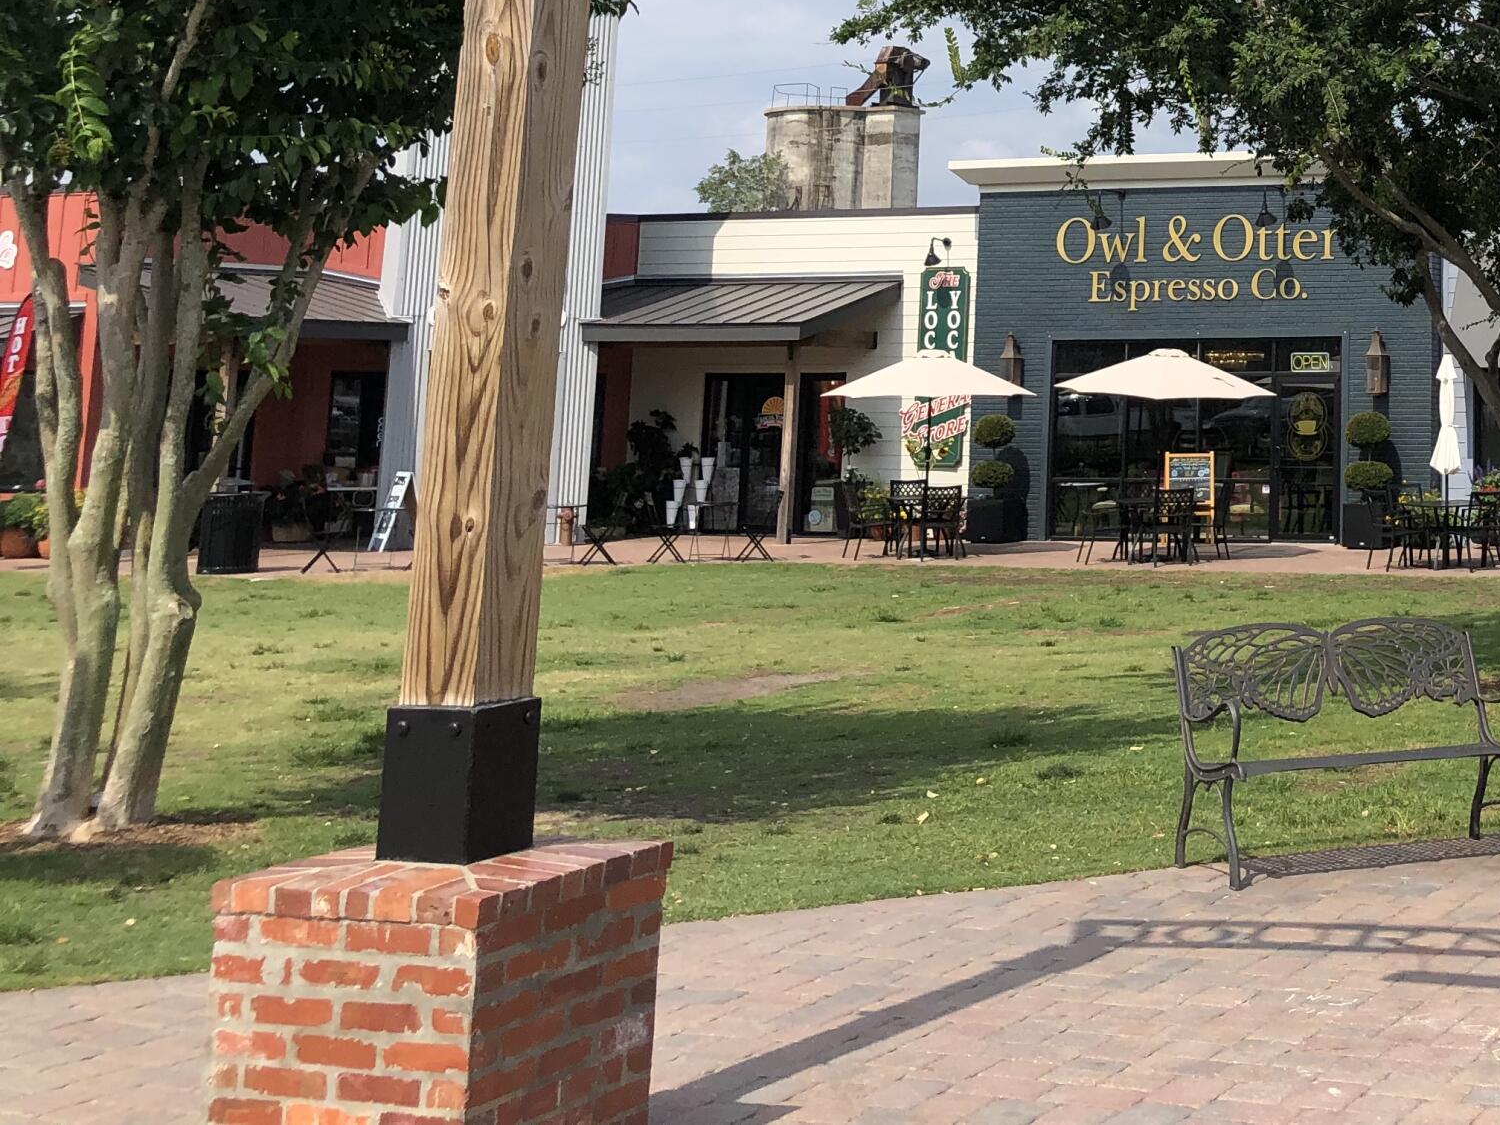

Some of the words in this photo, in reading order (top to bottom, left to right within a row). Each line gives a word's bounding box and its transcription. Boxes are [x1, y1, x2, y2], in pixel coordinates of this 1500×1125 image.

[1055, 215, 1148, 264] Owl
[1162, 215, 1202, 262] &
[1212, 213, 1338, 261] Otter
[1087, 270, 1240, 312] Espresso
[1250, 268, 1309, 301] Co.
[7, 316, 28, 373] HOT
[1292, 355, 1328, 370] OPEN
